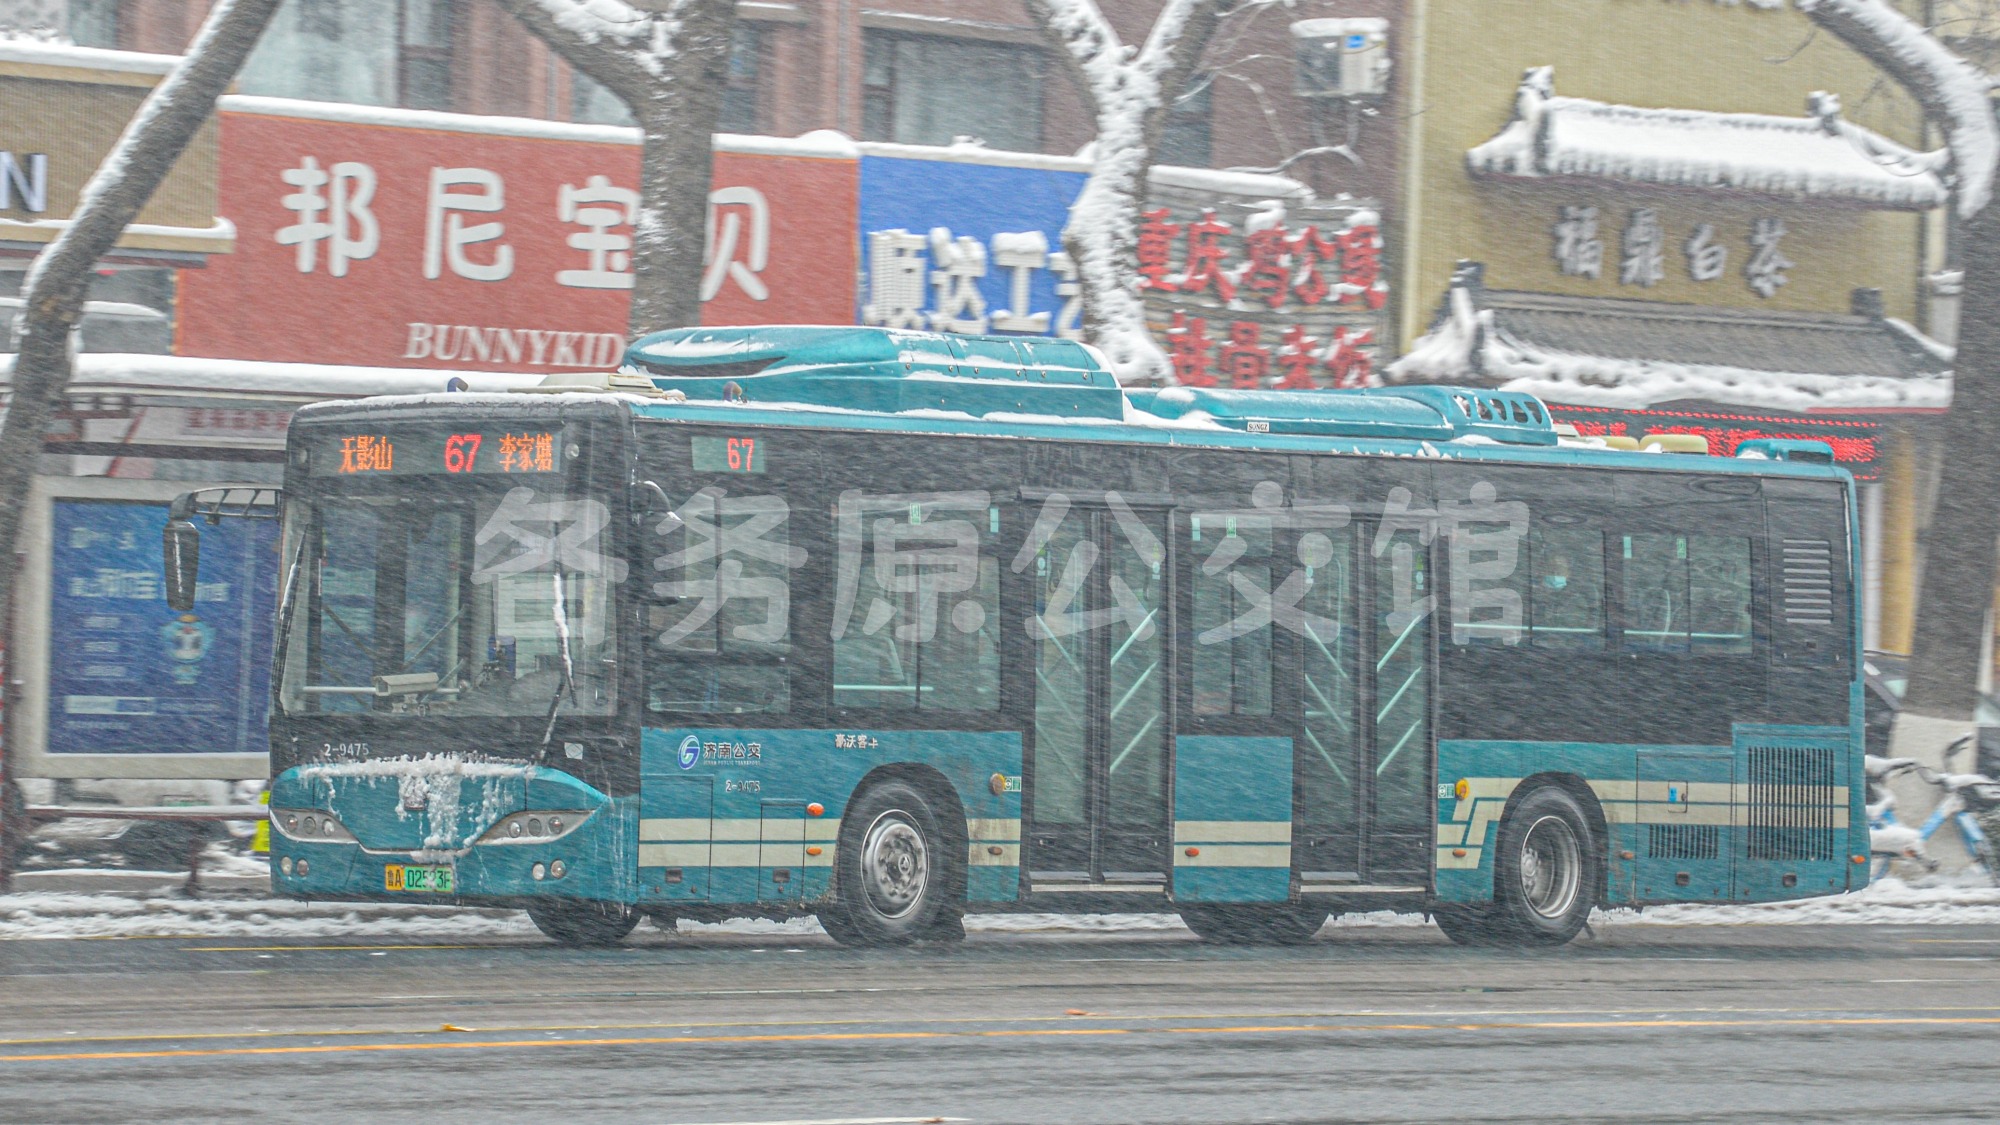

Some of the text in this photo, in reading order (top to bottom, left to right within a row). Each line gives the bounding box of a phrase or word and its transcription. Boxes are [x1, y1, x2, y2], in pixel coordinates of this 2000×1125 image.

[275, 155, 770, 302] 邦尼宝贝
[1552, 206, 1796, 298] 福鼎白茶
[338, 435, 393, 474] 无影山
[443, 434, 482, 473] 67
[727, 437, 754, 472] 67
[323, 743, 370, 757] 2-9475
[702, 741, 762, 759] 济南公交
[726, 779, 761, 793] 2-9475
